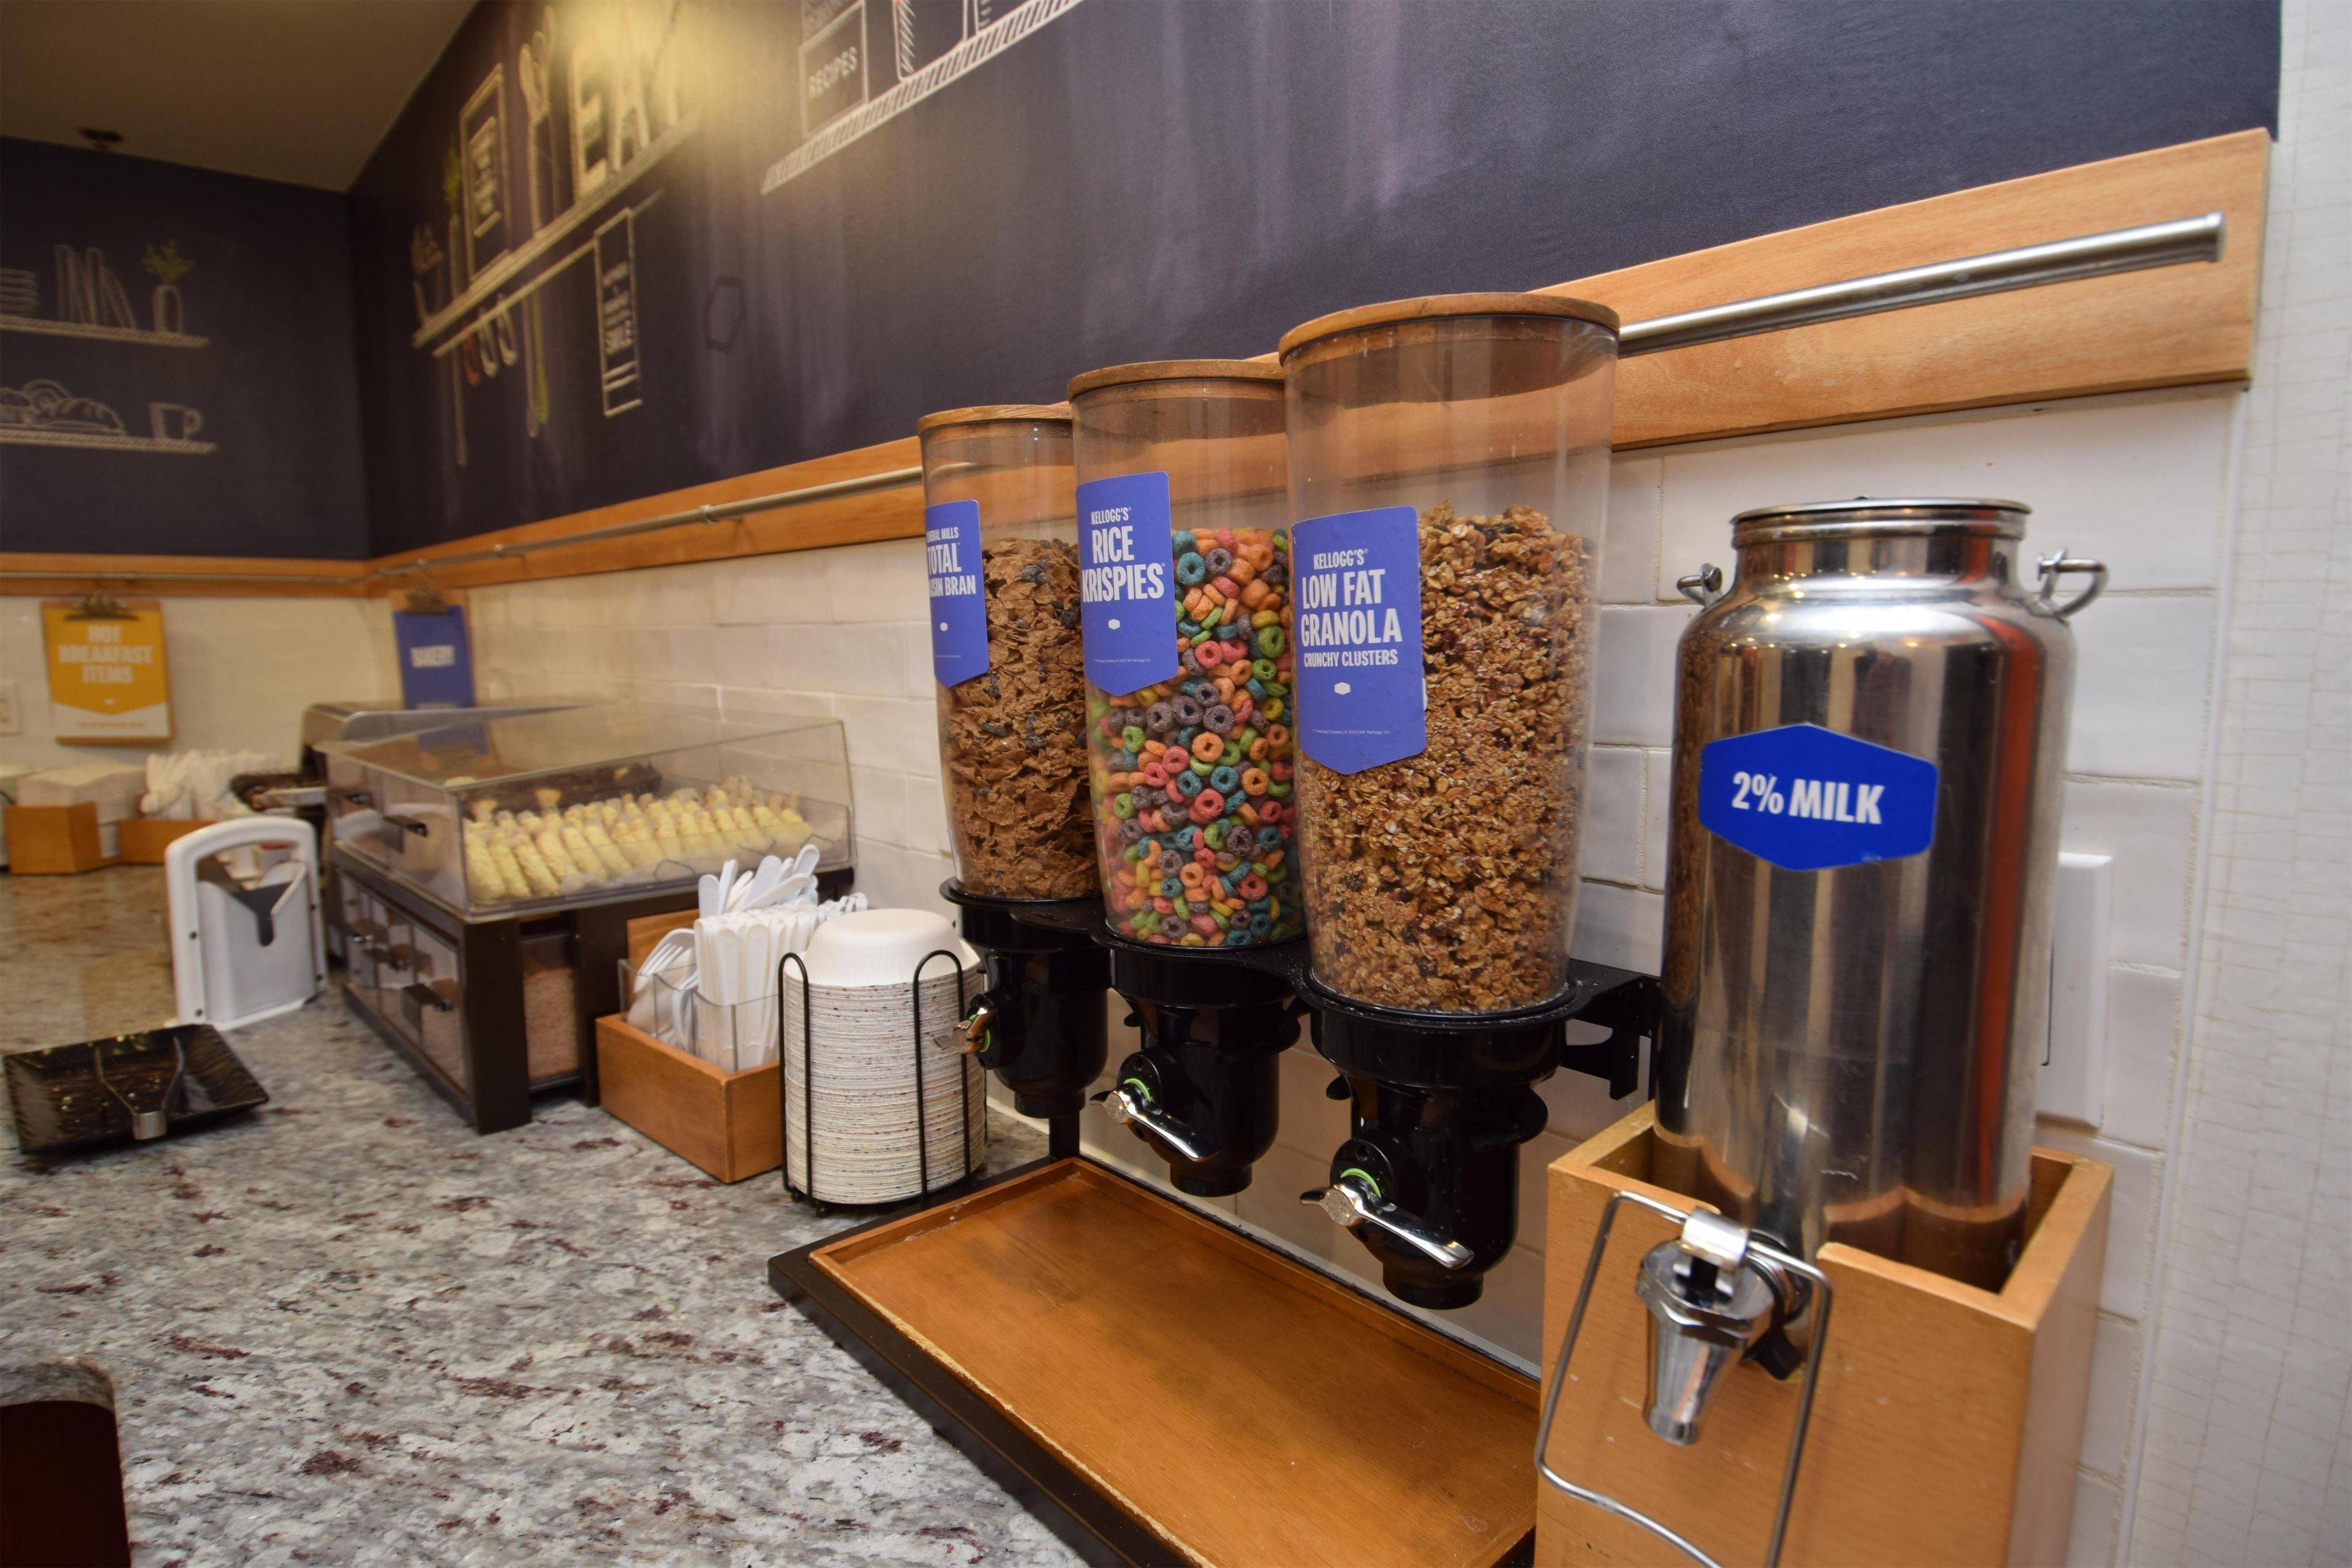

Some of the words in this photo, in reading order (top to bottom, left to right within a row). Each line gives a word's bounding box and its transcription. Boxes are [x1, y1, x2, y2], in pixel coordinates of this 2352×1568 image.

[809, 46, 858, 98] RECIPES
[926, 529, 941, 542] ENERAL
[941, 527, 959, 540] MILLS
[1092, 526, 1135, 564] RICE
[927, 543, 962, 575] TOTAL
[944, 575, 976, 596] BRAN
[1302, 573, 1338, 609] LOW
[1343, 569, 1385, 606] FAT
[88, 625, 122, 643] HOT
[1301, 608, 1403, 647] GRANOLA
[58, 644, 153, 664] BREAKFAST
[410, 645, 455, 668] BAKERY
[1304, 651, 1339, 668] CRUNCHY
[1341, 649, 1398, 666] CLUSTERS
[82, 665, 135, 683] ITEMS
[1732, 771, 1784, 815] 2%
[1789, 778, 1885, 825] MILK
